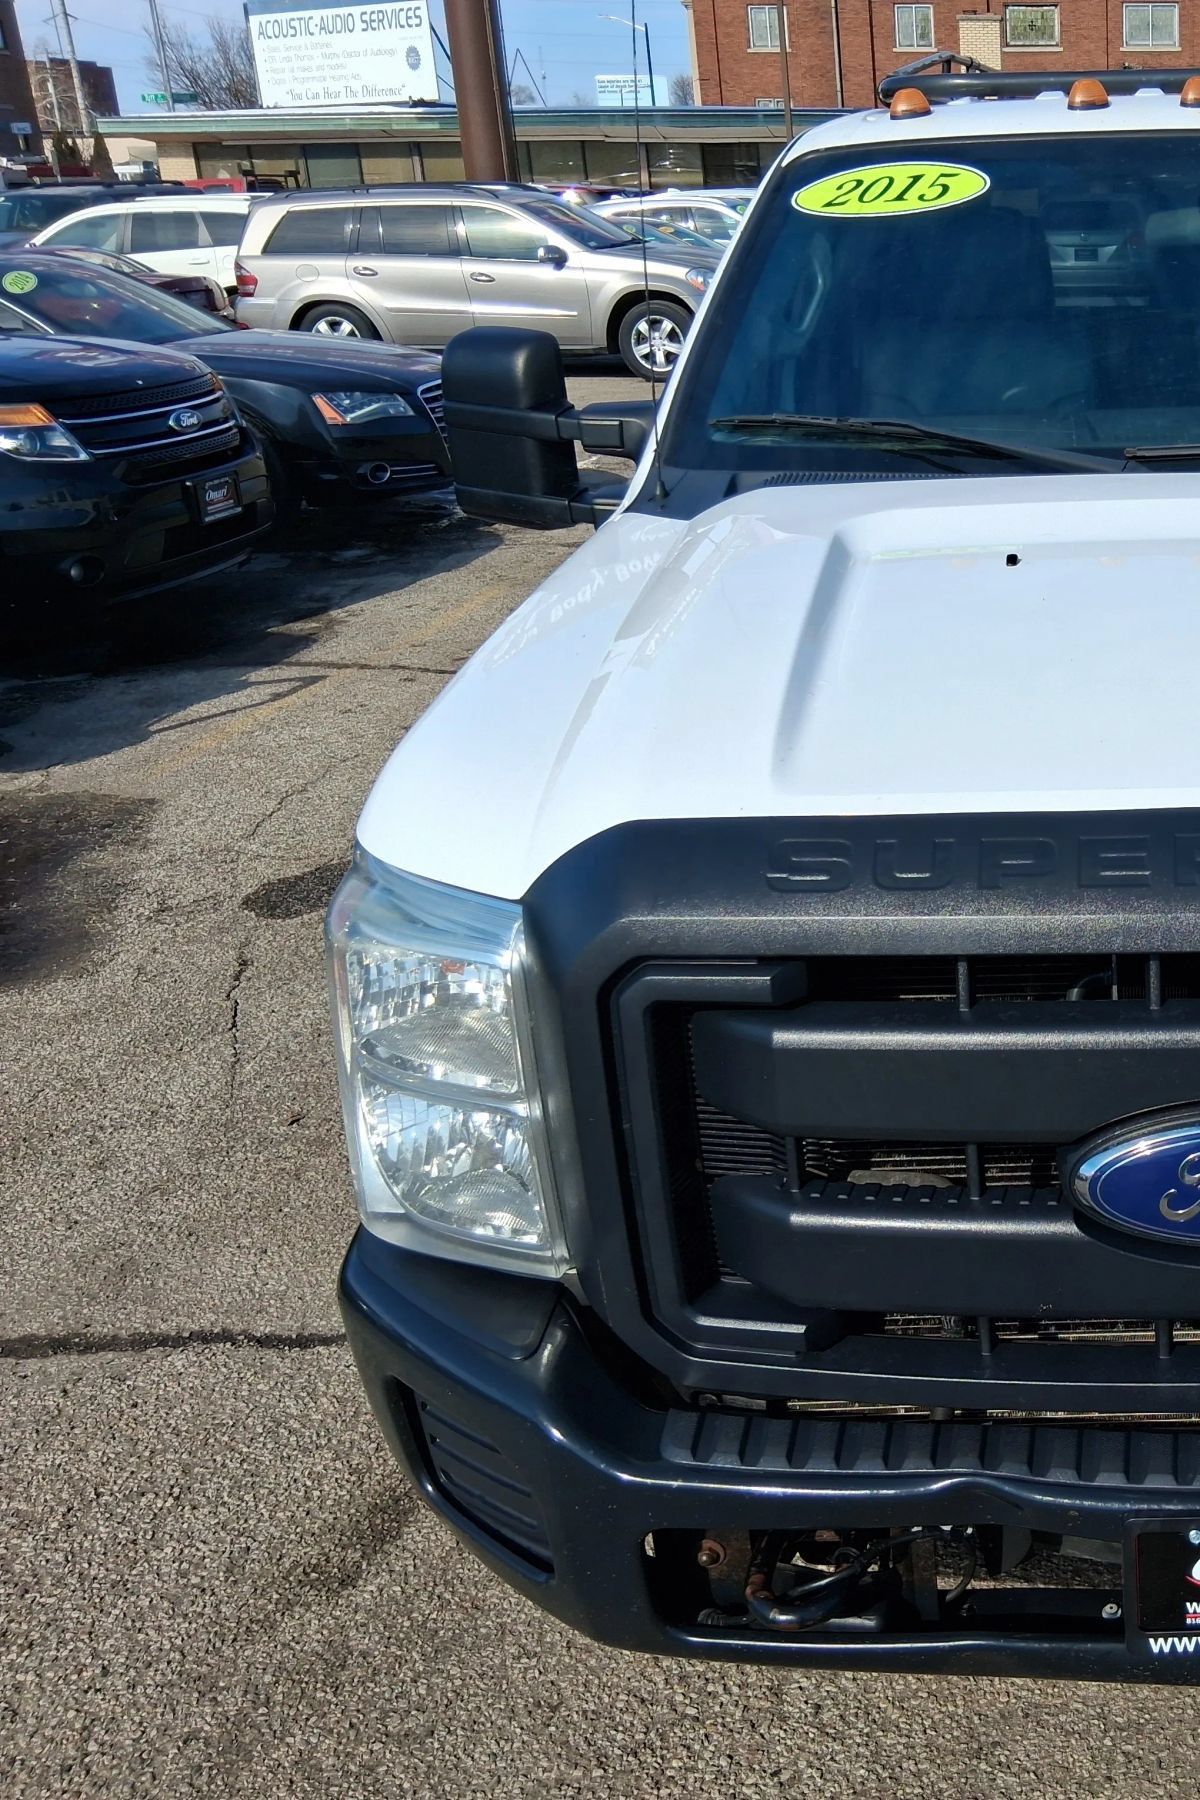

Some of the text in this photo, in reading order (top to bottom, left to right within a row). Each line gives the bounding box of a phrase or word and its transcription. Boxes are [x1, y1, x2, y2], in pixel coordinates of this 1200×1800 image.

[360, 6, 423, 33] SERVICES
[305, 87, 320, 100] Can
[323, 86, 341, 99] Hear
[344, 85, 359, 98] The
[821, 173, 961, 208] 2015
[180, 413, 199, 427] Ford
[206, 485, 228, 501] Omari
